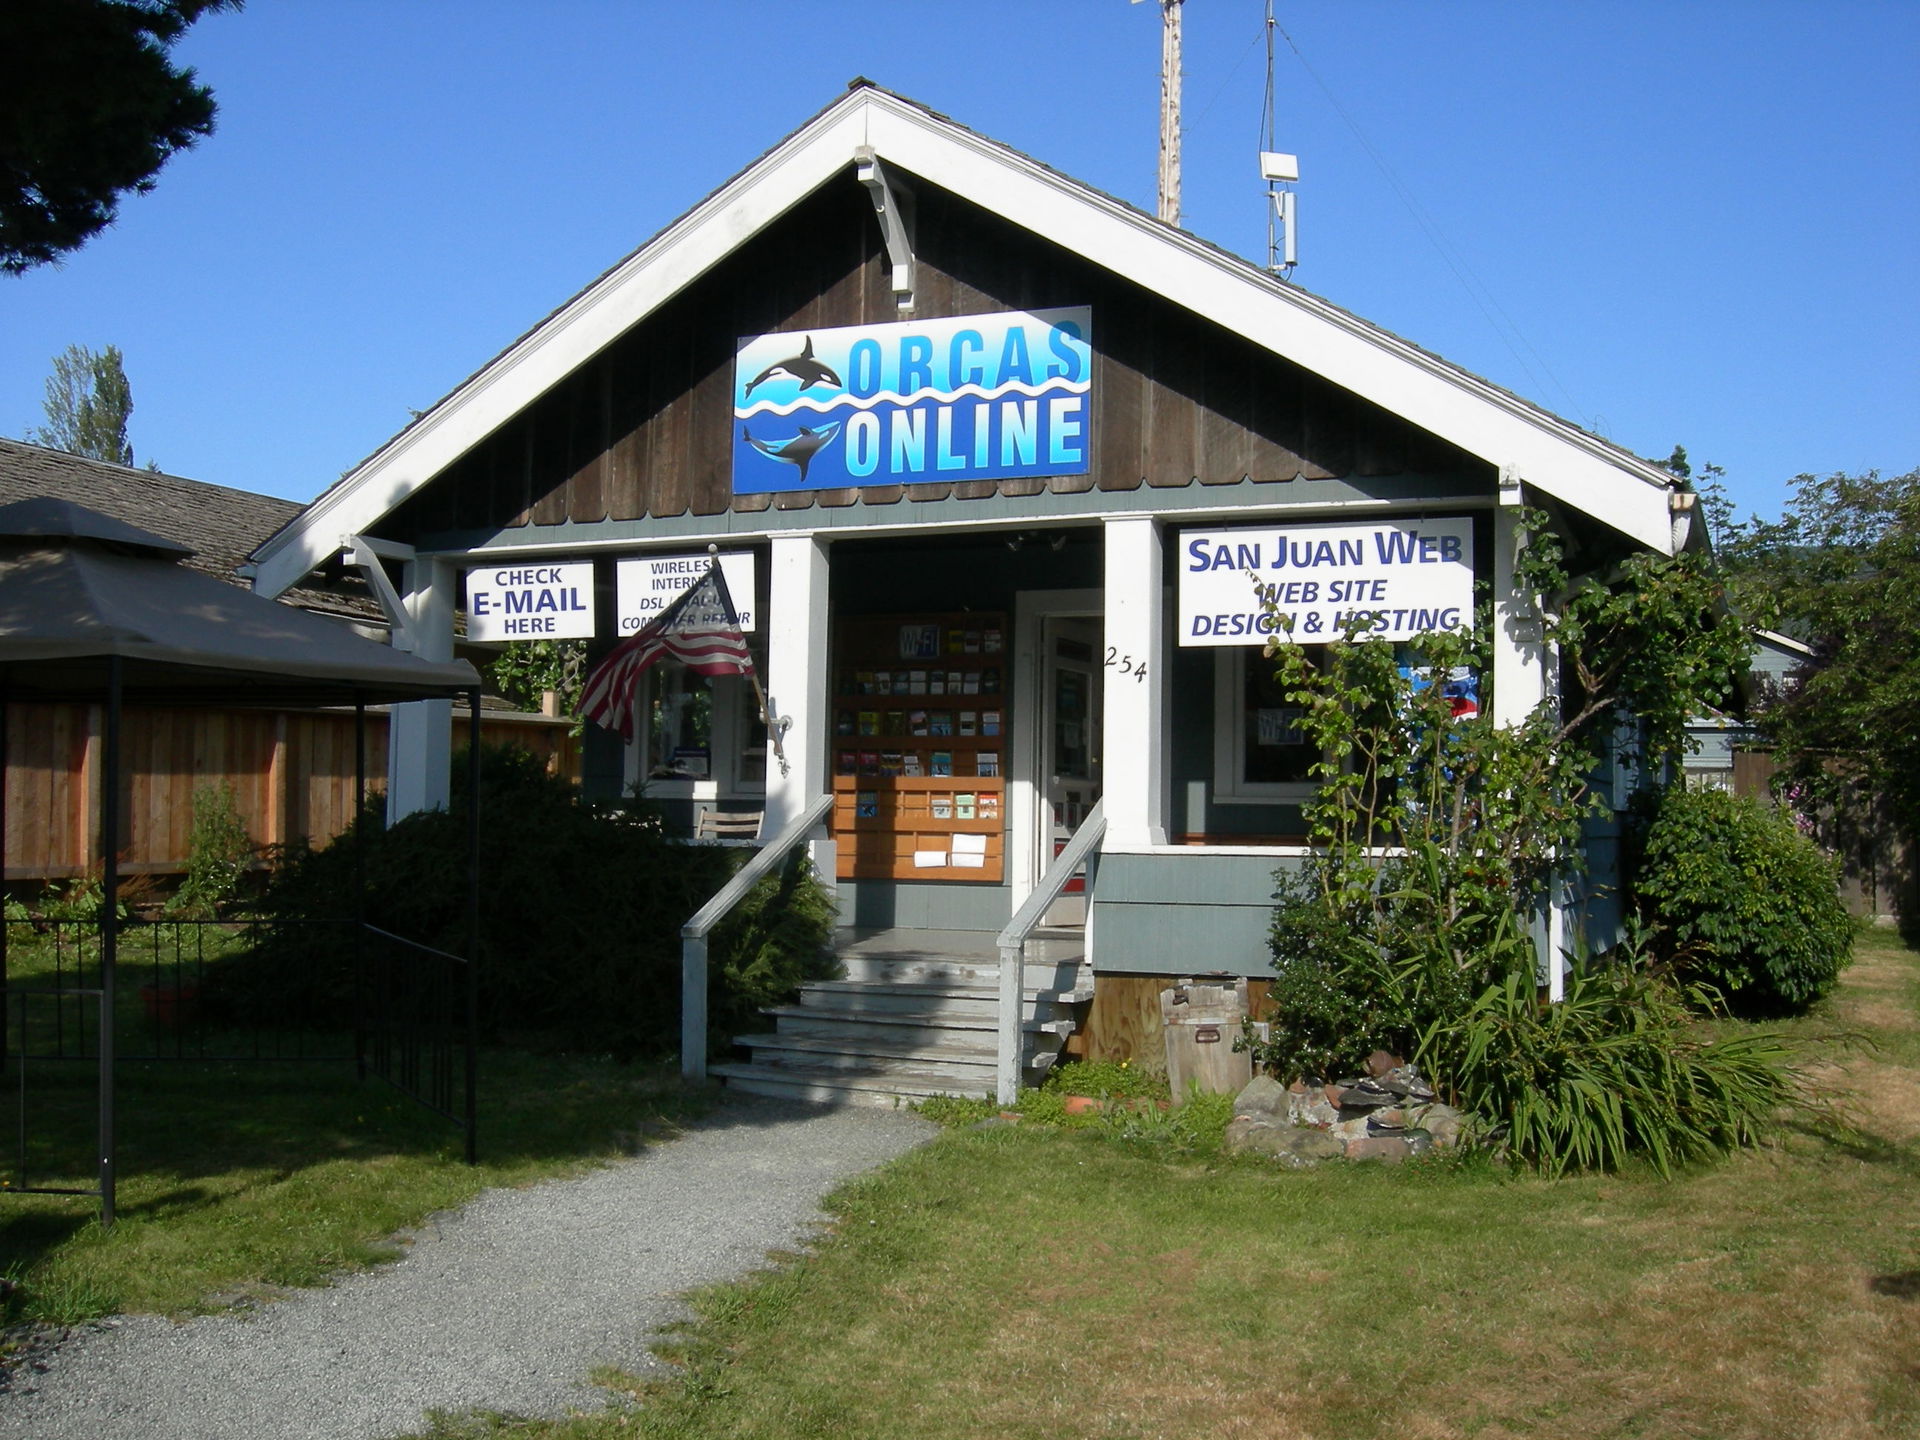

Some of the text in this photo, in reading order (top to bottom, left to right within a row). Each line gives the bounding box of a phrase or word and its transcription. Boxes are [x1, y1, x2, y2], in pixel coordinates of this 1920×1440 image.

[849, 320, 1083, 397] ORCAS
[845, 396, 1083, 477] ONLINE
[1188, 530, 1463, 572] SAN JUAN WEB
[495, 567, 562, 587] CHECK
[650, 559, 712, 575] WIRELES
[651, 576, 704, 591] INTERN
[1258, 578, 1388, 604] WEB SITE
[473, 587, 587, 616] E-MAIL
[639, 597, 665, 611] DSL
[503, 616, 556, 635] HERE
[702, 611, 751, 626] REPIR
[1191, 607, 1461, 637] DESIGN & HOSTING
[1103, 645, 1148, 684] 254
